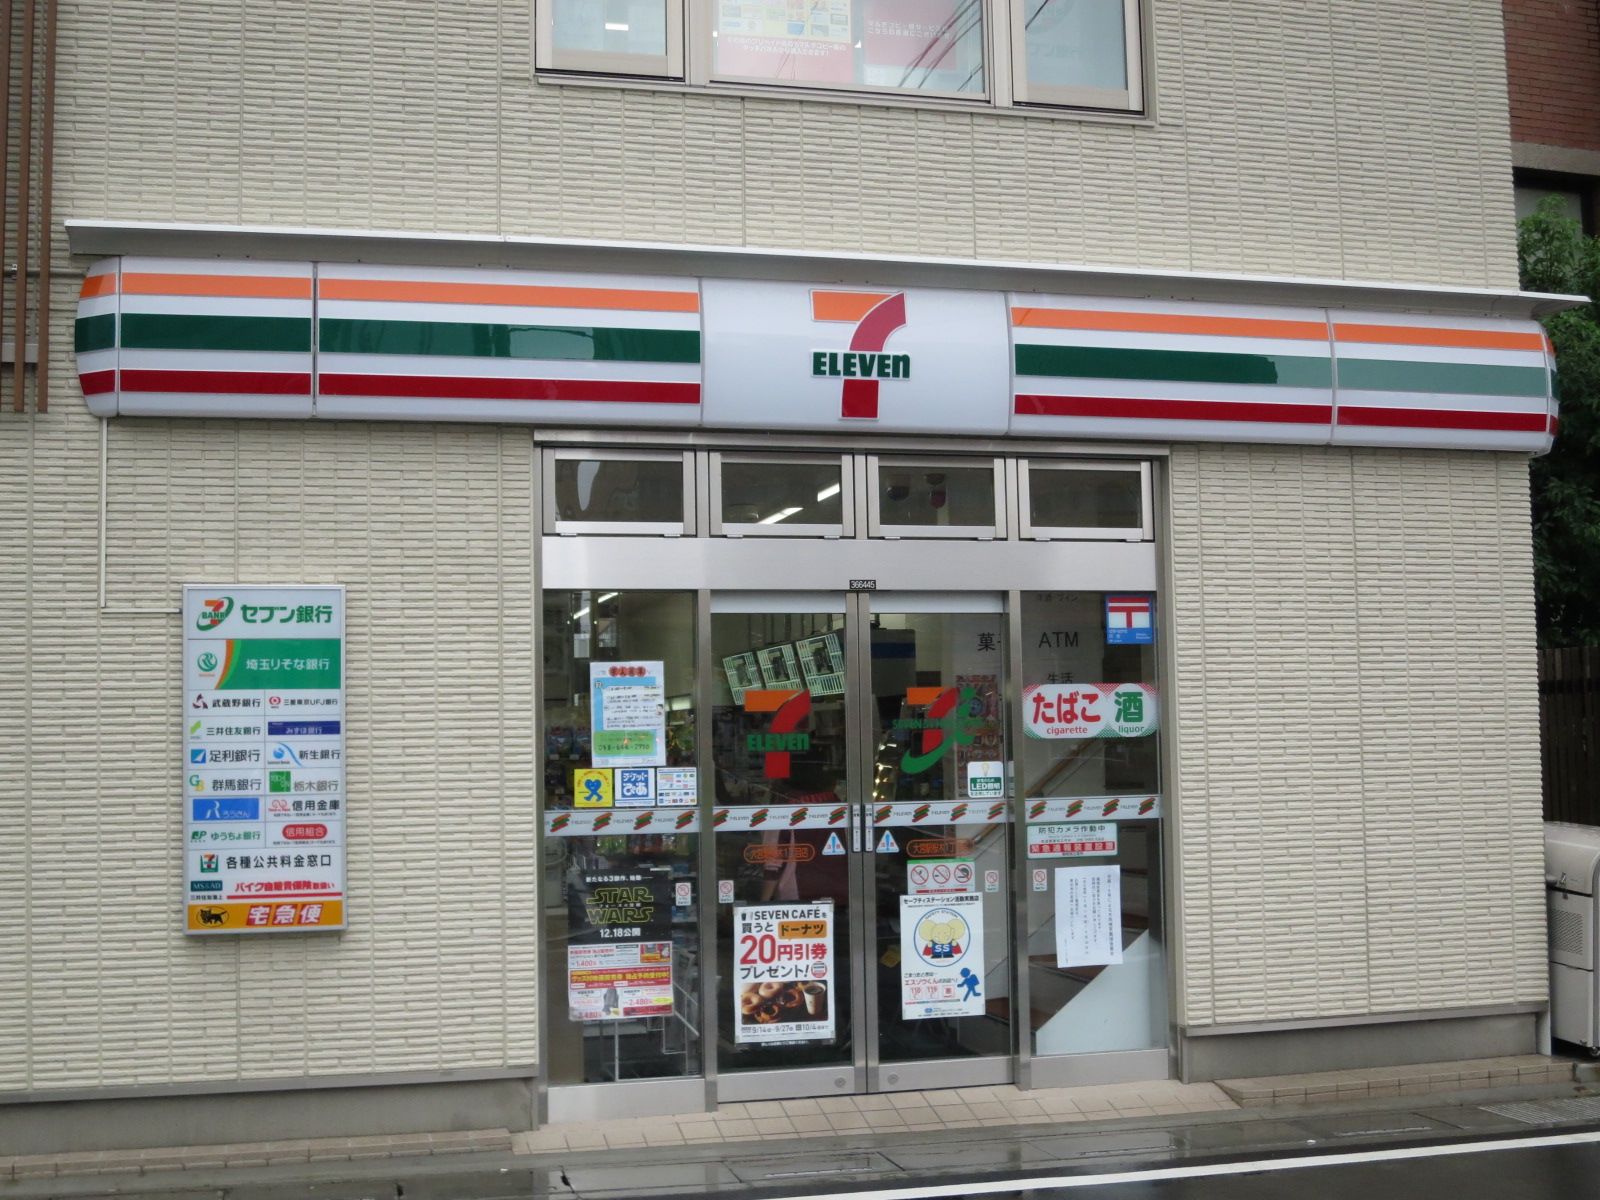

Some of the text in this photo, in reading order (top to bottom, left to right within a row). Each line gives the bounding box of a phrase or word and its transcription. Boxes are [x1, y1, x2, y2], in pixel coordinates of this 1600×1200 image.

[240, 604, 333, 624] セブン銀行
[1038, 632, 1079, 648] ATM
[246, 658, 330, 670] 埼玉りそな銀行
[212, 698, 261, 709] 武蔵野銀行
[1032, 690, 1144, 724] たばこ 酒
[206, 726, 261, 736] 三井住友銀行
[1046, 726, 1144, 736] cigarette liquor
[208, 750, 261, 762] 足利銀行
[299, 750, 341, 760] 新生銀行
[212, 778, 262, 792] 群馬銀行
[294, 780, 339, 792] 栃木銀行
[292, 800, 340, 811] 信用金庫
[285, 826, 325, 836] 信用組合
[1038, 825, 1106, 834] 防犯カメラ作動中
[210, 831, 261, 841] ゆうちょ銀行
[226, 854, 332, 869] 各種公共料金窓口
[586, 887, 654, 904] STAR
[248, 904, 322, 925] 宅急便
[586, 906, 654, 924] WARS
[754, 910, 790, 920] SEVEN
[792, 906, 820, 919] CAFÉ
[600, 928, 641, 938] 12.18公開
[742, 922, 824, 936] 買うと ドーナツ
[740, 934, 827, 964] 20円引券
[935, 944, 950, 953] SS
[740, 964, 809, 980] プレゼント!
